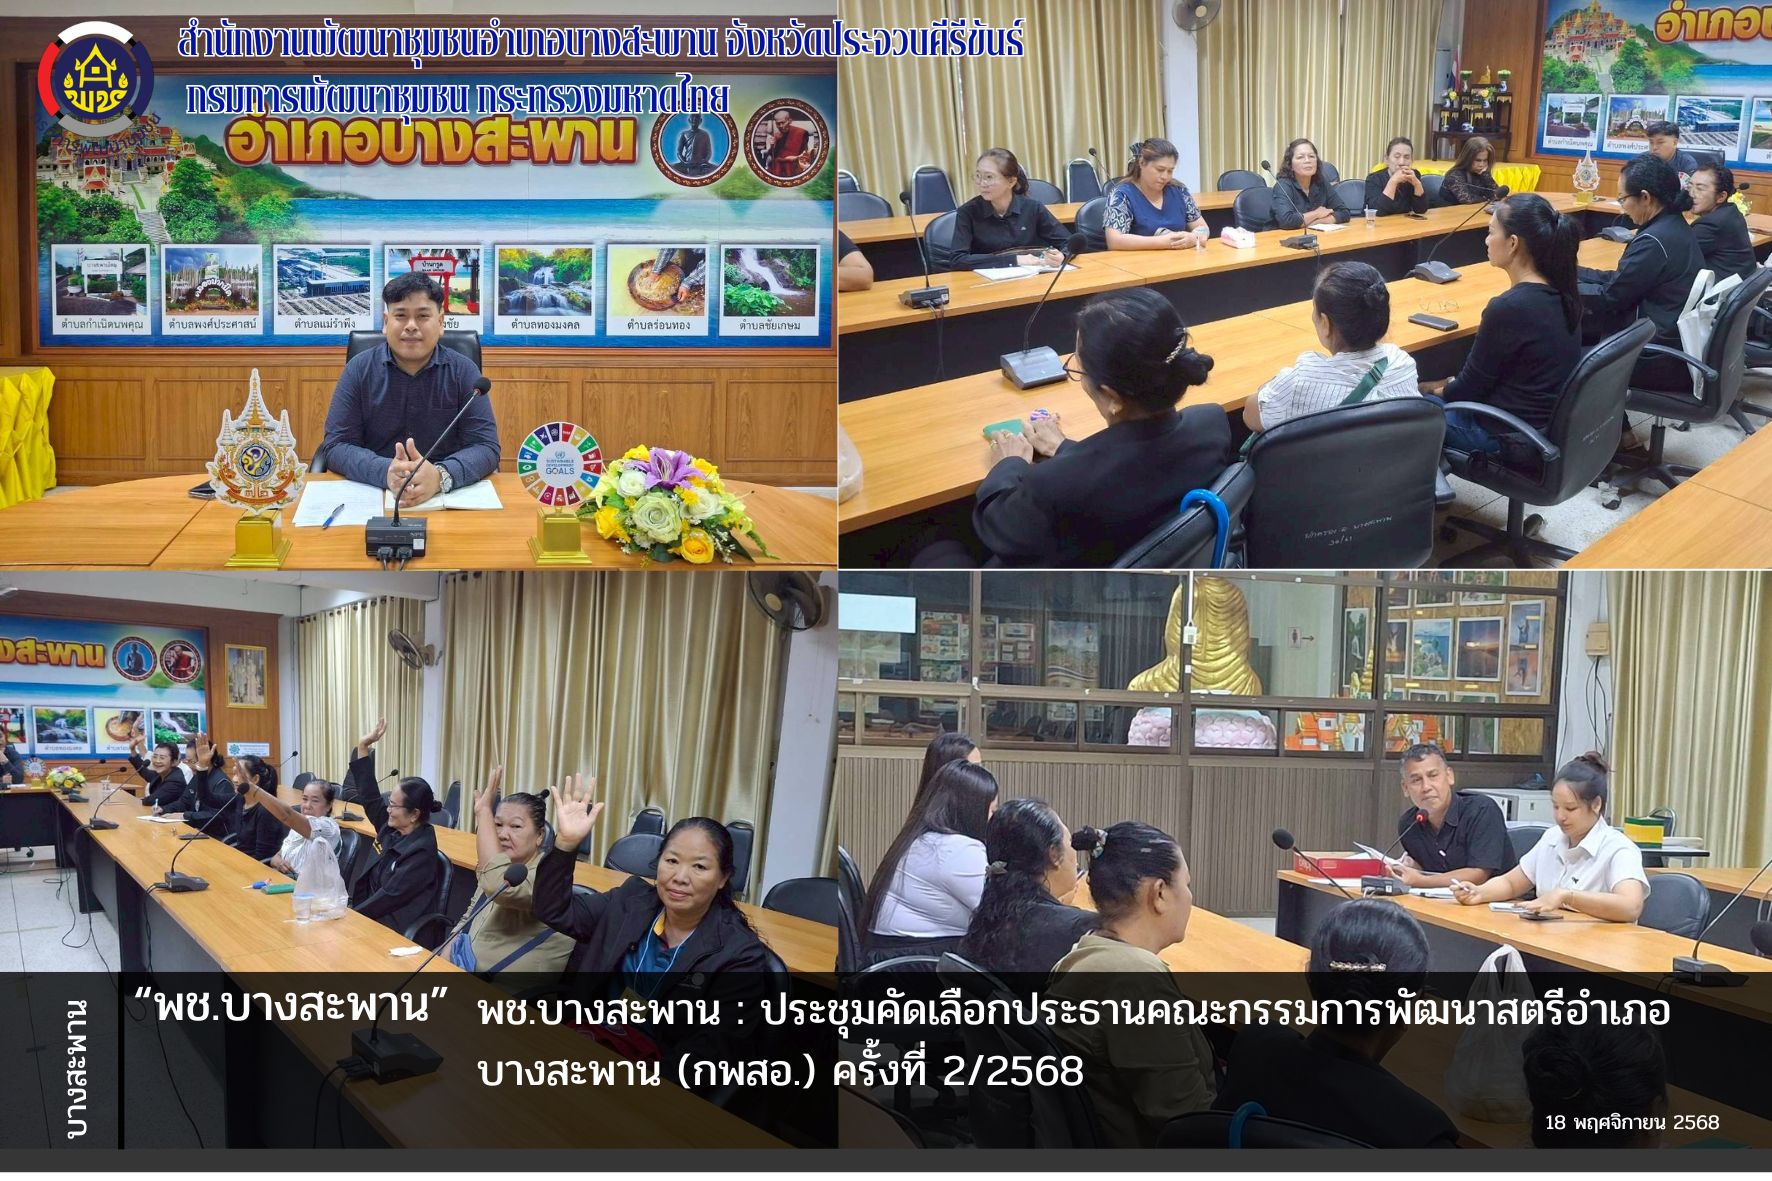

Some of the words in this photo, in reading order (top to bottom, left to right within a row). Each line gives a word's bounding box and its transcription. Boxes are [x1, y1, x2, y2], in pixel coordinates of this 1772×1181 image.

[225, 100, 638, 166] อำเภอบางสะพาน
[61, 317, 144, 333] ตำบลกำเนิดนพคุณ
[168, 316, 257, 330] ตำบลพงศ์ประศาสน์
[511, 318, 581, 331] ตำบลทองมงคล
[627, 318, 691, 331] ตำบลร่อนทอง
[739, 318, 801, 331] ตำบลชัยเกษม
[545, 467, 575, 475] GOALS
